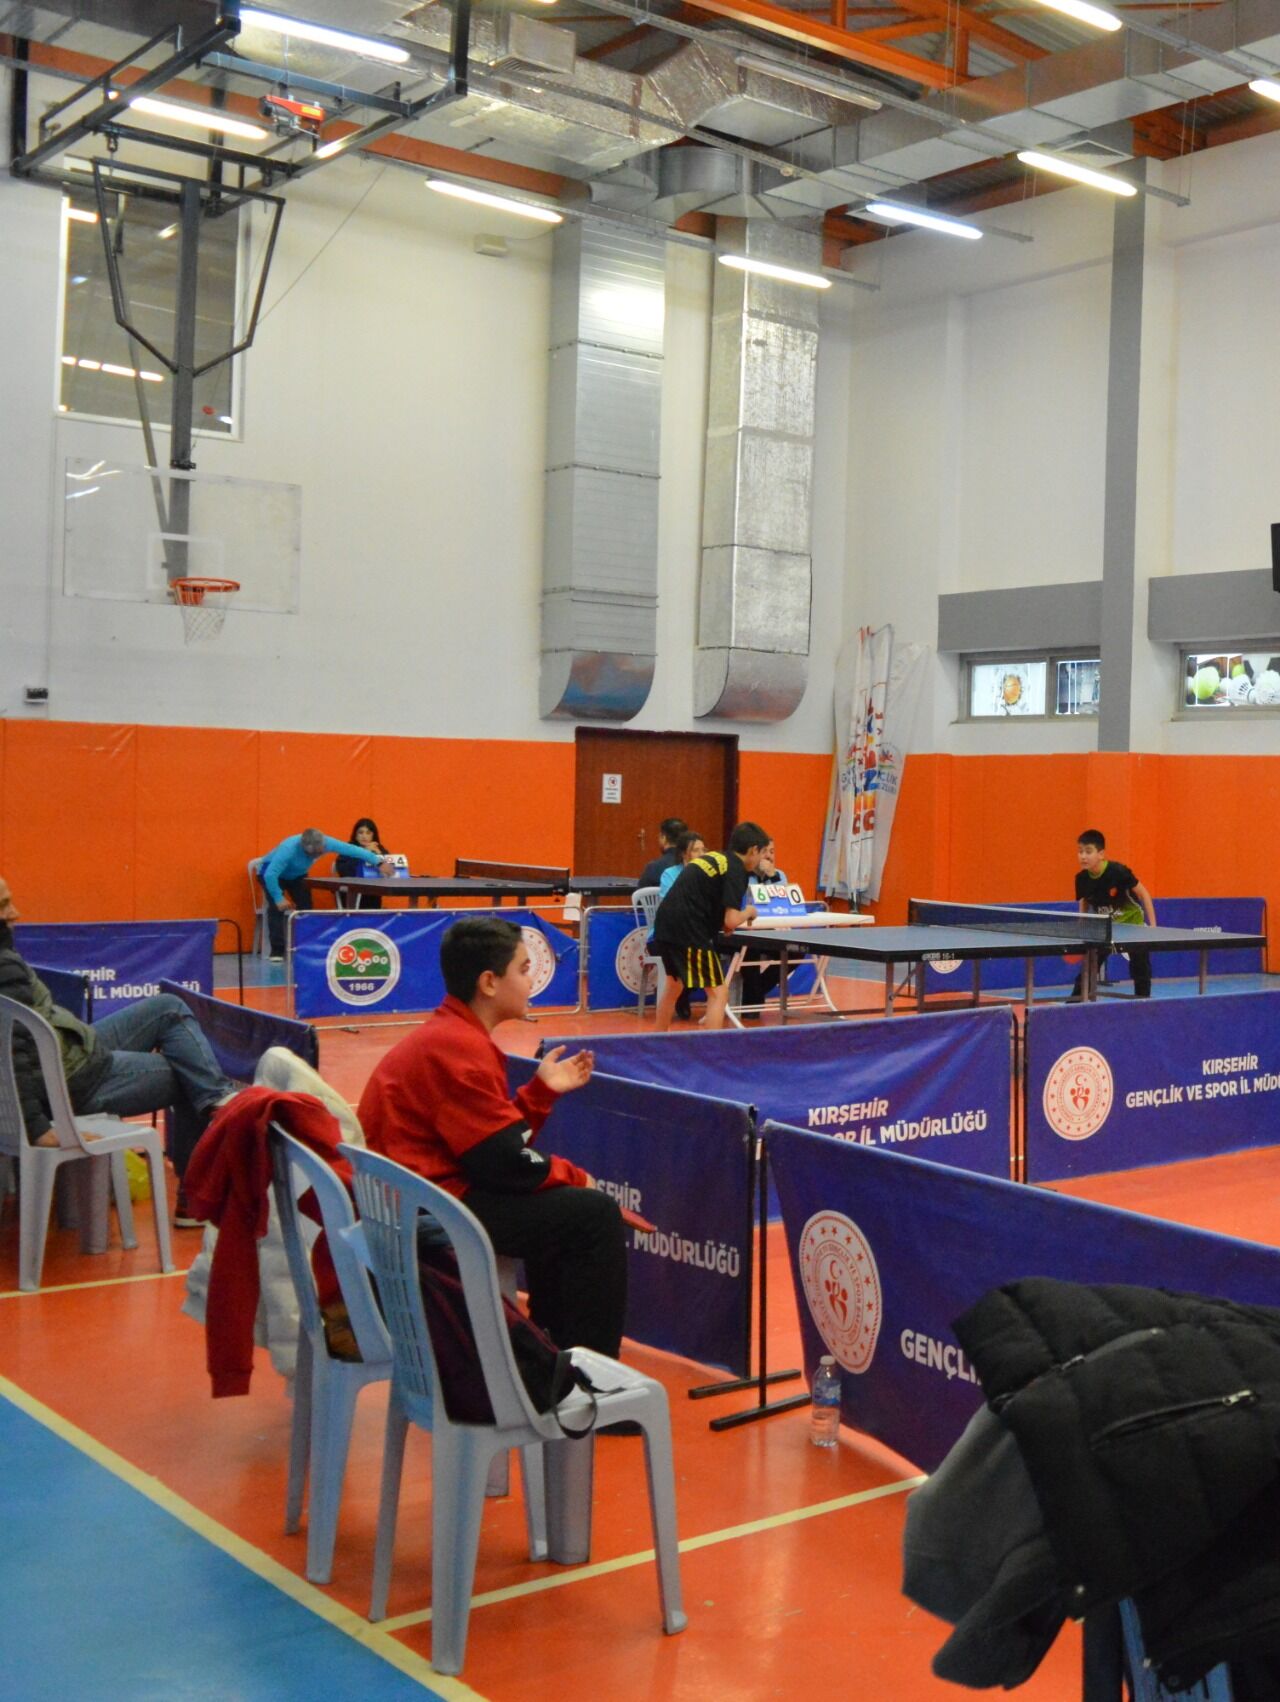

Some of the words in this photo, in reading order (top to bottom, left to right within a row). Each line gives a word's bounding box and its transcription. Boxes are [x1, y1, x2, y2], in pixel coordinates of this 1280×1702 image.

[758, 888, 766, 901] 6
[791, 889, 801, 904] 0
[349, 983, 375, 991] 1966
[1202, 1052, 1258, 1077] KIRŞEHİR
[1126, 1085, 1183, 1109] GENÇLİK
[1186, 1079, 1203, 1101] VE
[1205, 1074, 1238, 1098] SPOR
[1240, 1069, 1251, 1093] İL
[808, 1097, 889, 1127] KIRŞEHİR
[860, 1125, 876, 1146] İL
[880, 1109, 987, 1144] MÜDÜRLÜĞÜ
[901, 1328, 982, 1386] GENÇL
